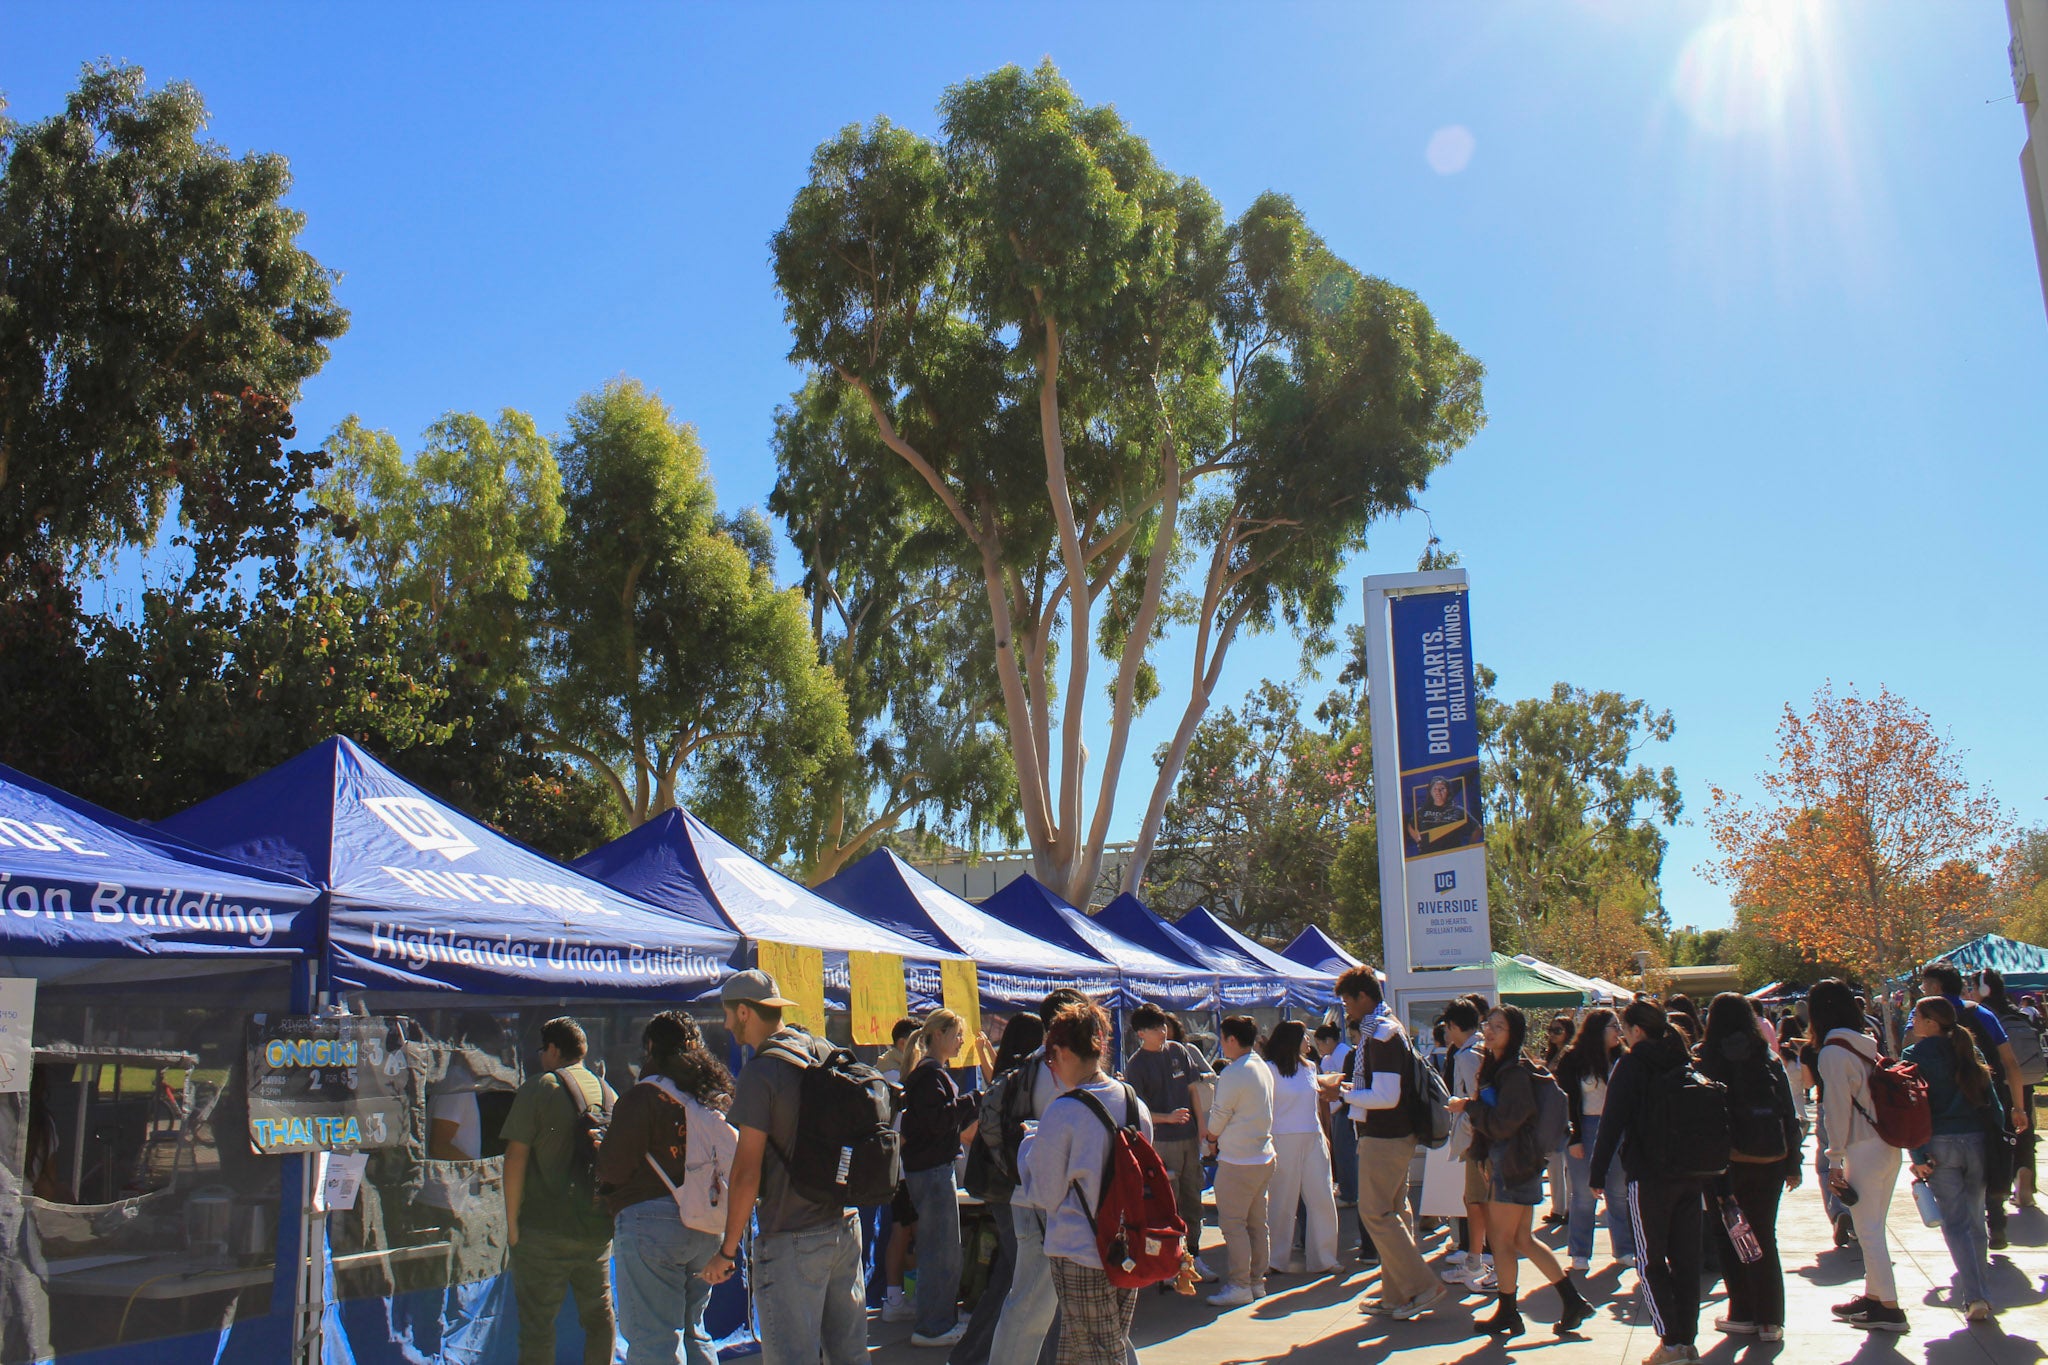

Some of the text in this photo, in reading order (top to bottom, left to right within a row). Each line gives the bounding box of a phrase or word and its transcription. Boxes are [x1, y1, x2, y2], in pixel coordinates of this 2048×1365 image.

[1443, 600, 1467, 722] BRILLIANT MINDS.
[1422, 626, 1451, 754] BOLD HEARTS.
[380, 804, 459, 840] UC
[379, 865, 622, 916] RIVERSIDE
[1437, 874, 1453, 888] UC
[91, 881, 274, 947] Building
[1417, 898, 1479, 914] RIVERSIDE
[1425, 926, 1453, 935] BRILLIANT
[1430, 919, 1445, 927] BOLD
[372, 921, 540, 971] Highlander
[547, 936, 622, 973] Union
[628, 943, 722, 985] Building
[989, 973, 1044, 1001] Highlander
[1128, 977, 1168, 1000] Highlander
[266, 1039, 358, 1069] ONIGIRI
[309, 1069, 322, 1091] 2
[252, 1117, 314, 1147] THAI
[315, 1116, 362, 1146] TEA
